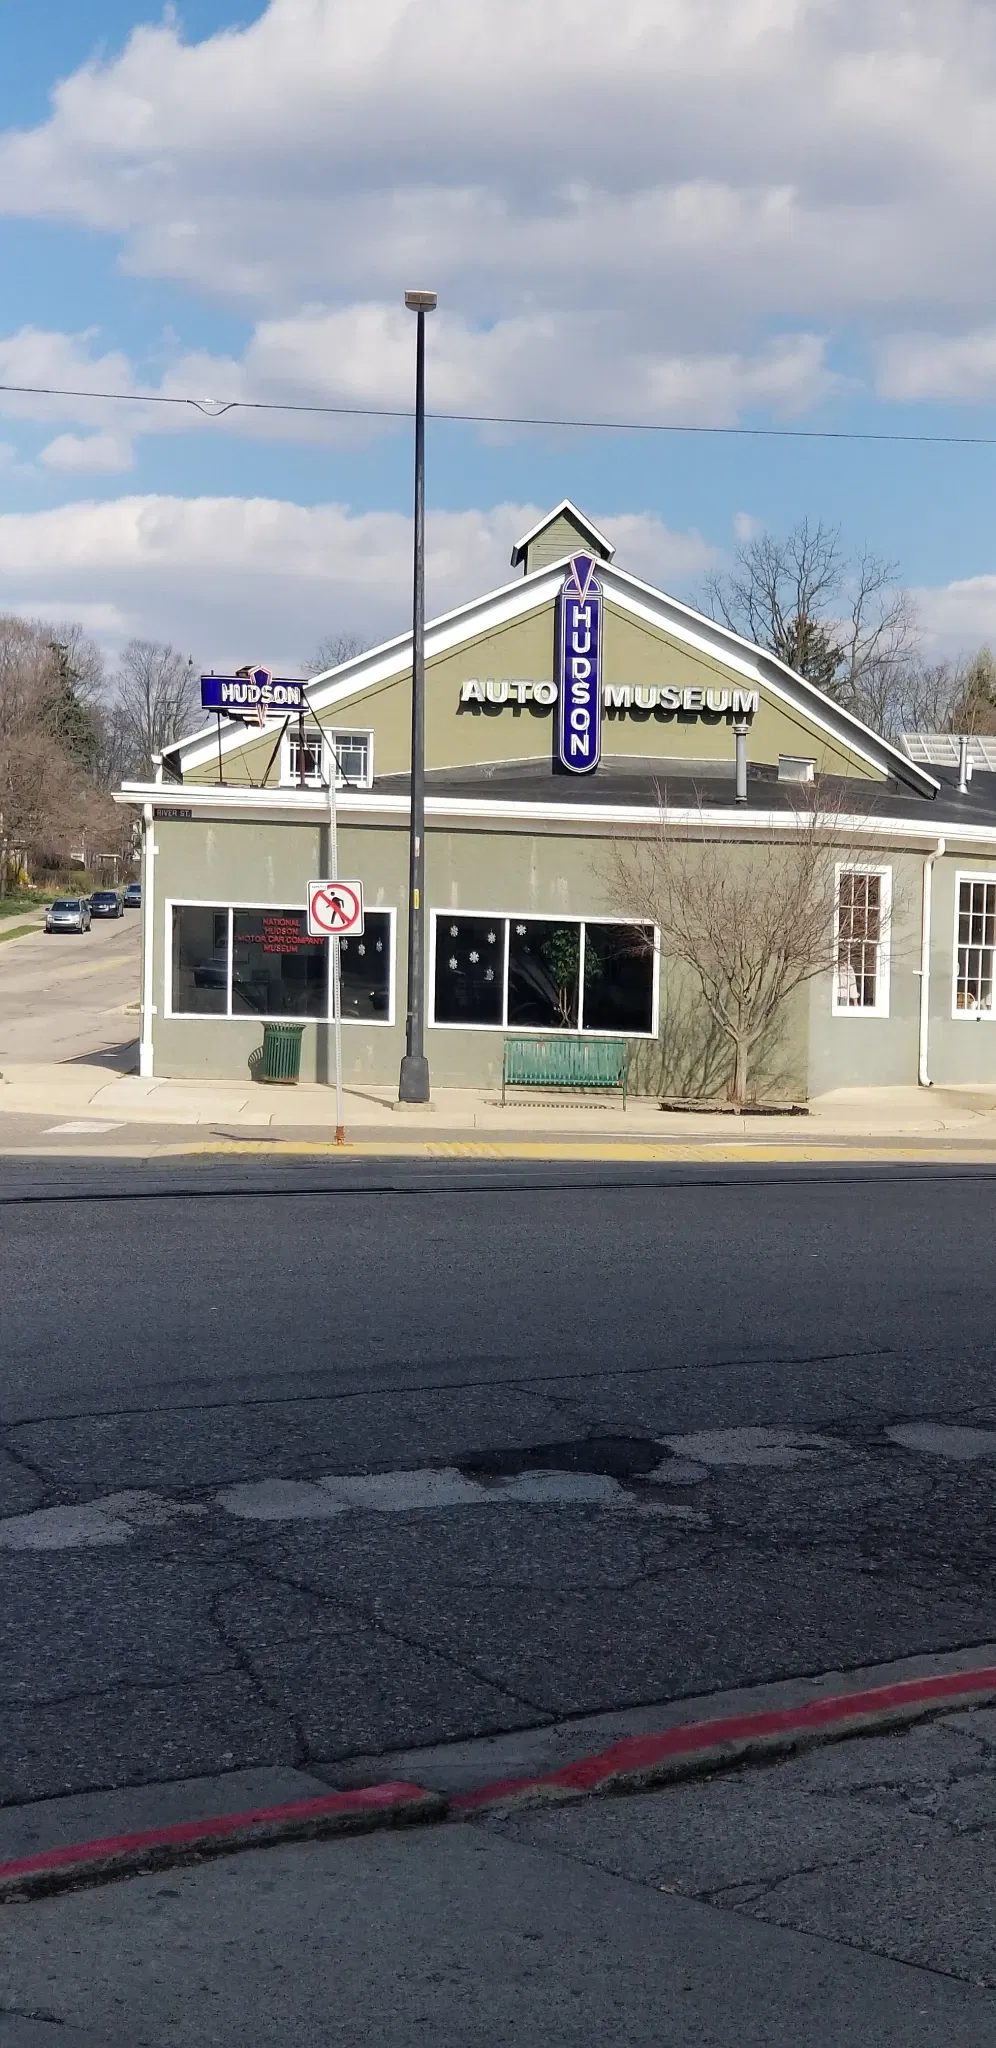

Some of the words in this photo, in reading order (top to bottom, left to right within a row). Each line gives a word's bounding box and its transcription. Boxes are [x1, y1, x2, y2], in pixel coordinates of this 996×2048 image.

[570, 605, 592, 756] HUDSON
[221, 683, 300, 704] HUDSON
[460, 678, 558, 704] AUTO
[604, 684, 760, 712] MUSEUM
[156, 809, 178, 817] RIVER
[263, 918, 300, 927] NATIONAL
[264, 927, 298, 935] HUDSON
[237, 935, 267, 943] MOTOR
[268, 935, 285, 943] CAR
[286, 935, 325, 945] COMPANY
